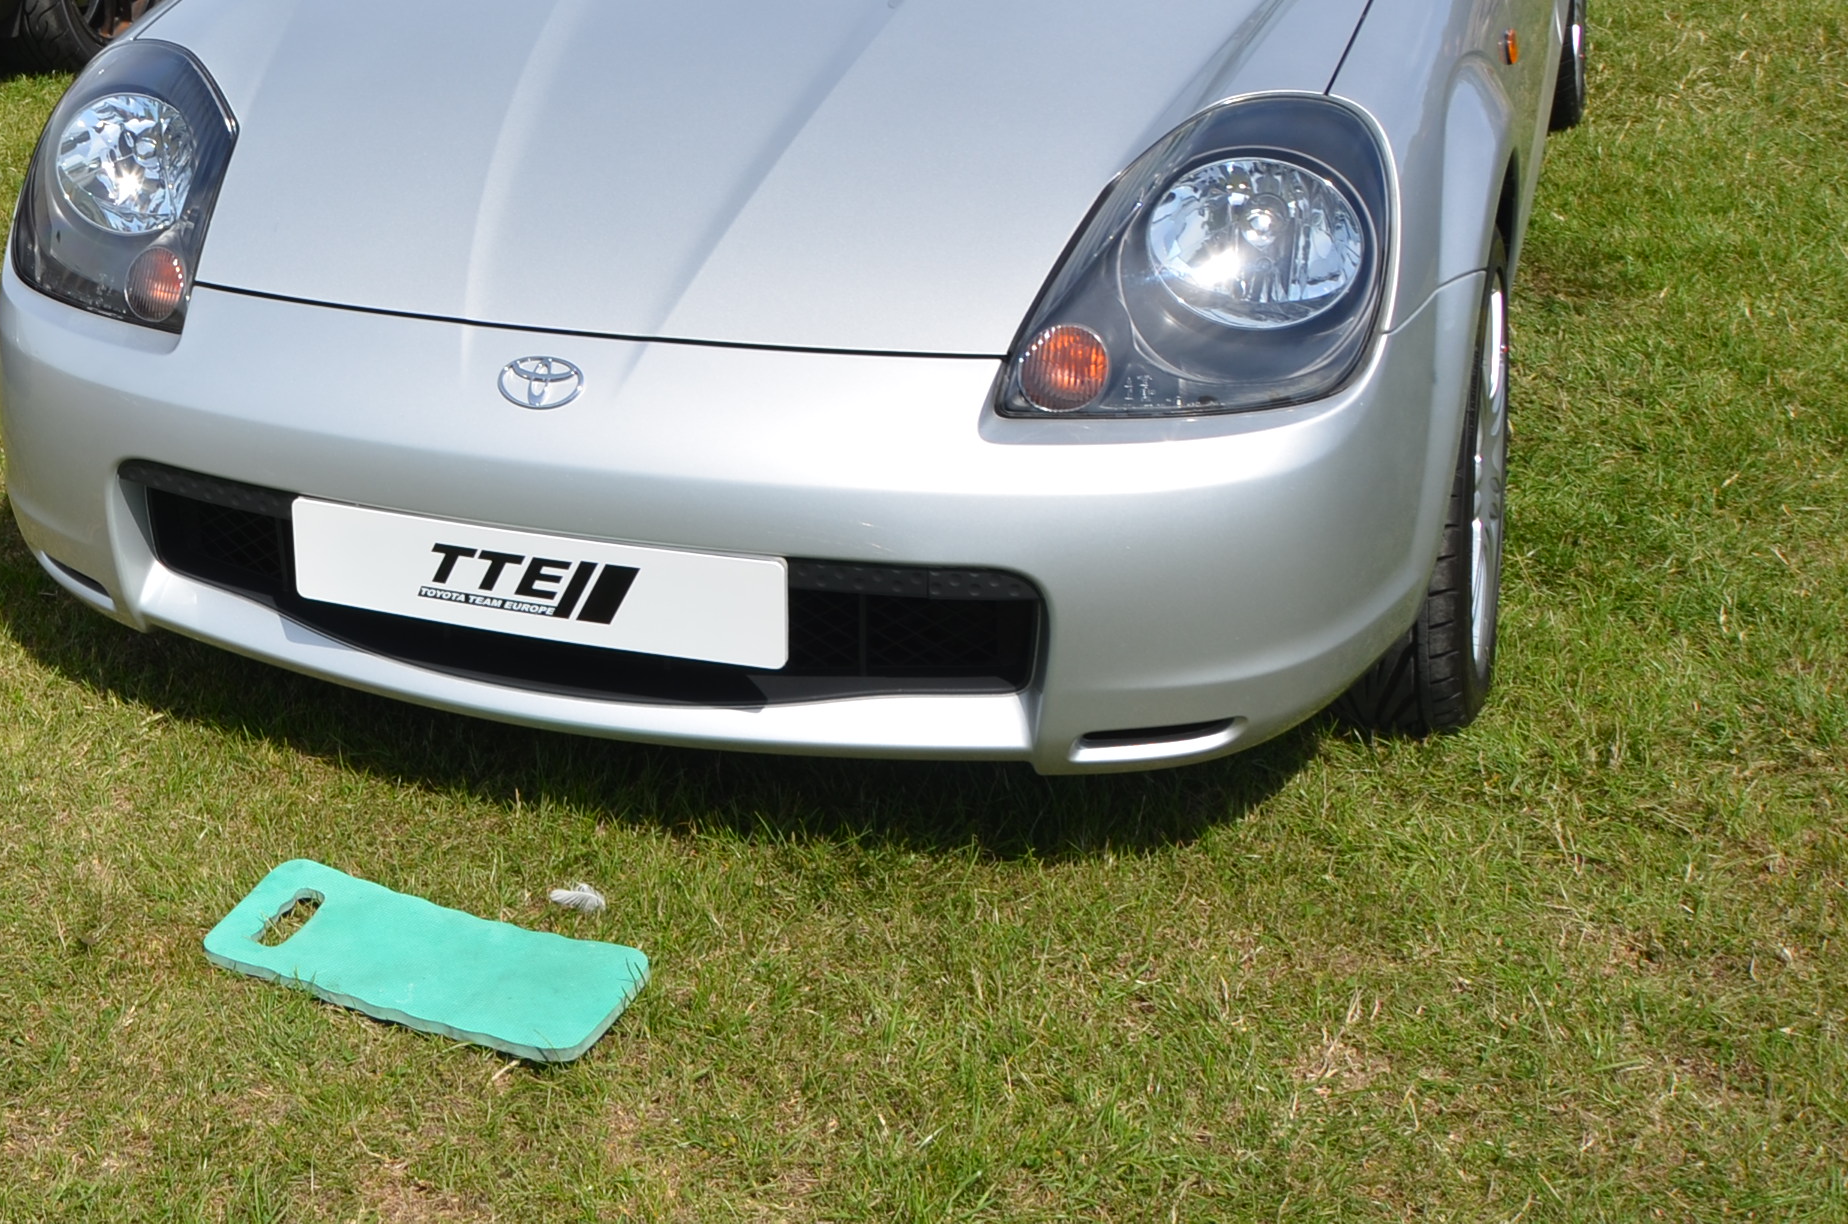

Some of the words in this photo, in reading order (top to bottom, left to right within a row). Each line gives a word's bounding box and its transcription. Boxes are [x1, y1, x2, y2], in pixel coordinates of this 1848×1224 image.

[431, 542, 573, 600] TTE
[420, 587, 466, 603] TOYOTA
[468, 594, 502, 608] TEAM
[503, 601, 555, 616] EUROPE
